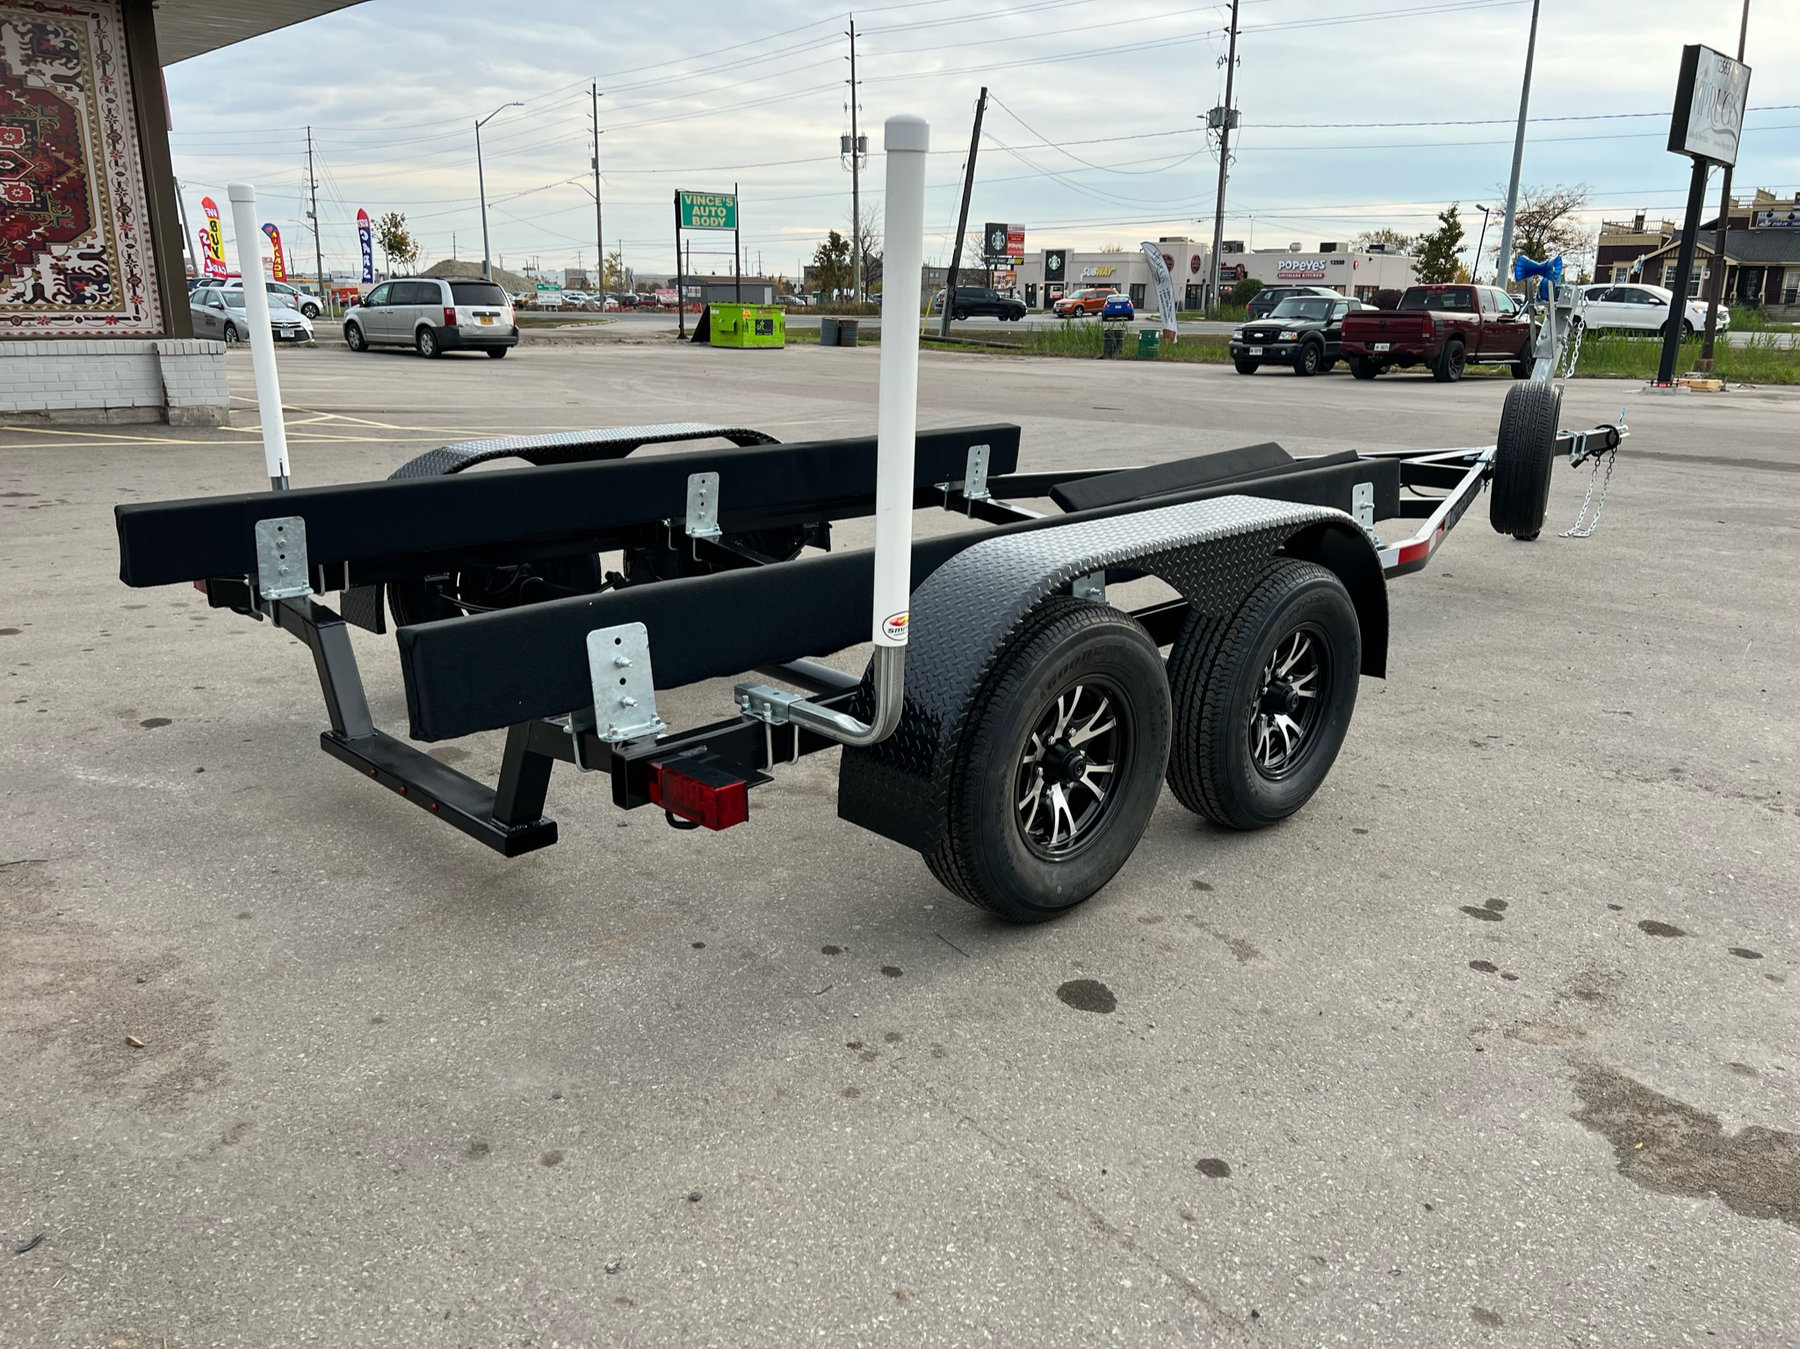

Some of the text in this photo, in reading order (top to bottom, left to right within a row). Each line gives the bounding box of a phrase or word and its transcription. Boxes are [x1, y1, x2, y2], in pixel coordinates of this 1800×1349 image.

[684, 194, 734, 207] VINCE'S
[692, 205, 727, 217] AUTO
[692, 216, 726, 227] BODY
[1082, 265, 1117, 278] SUBWAY
